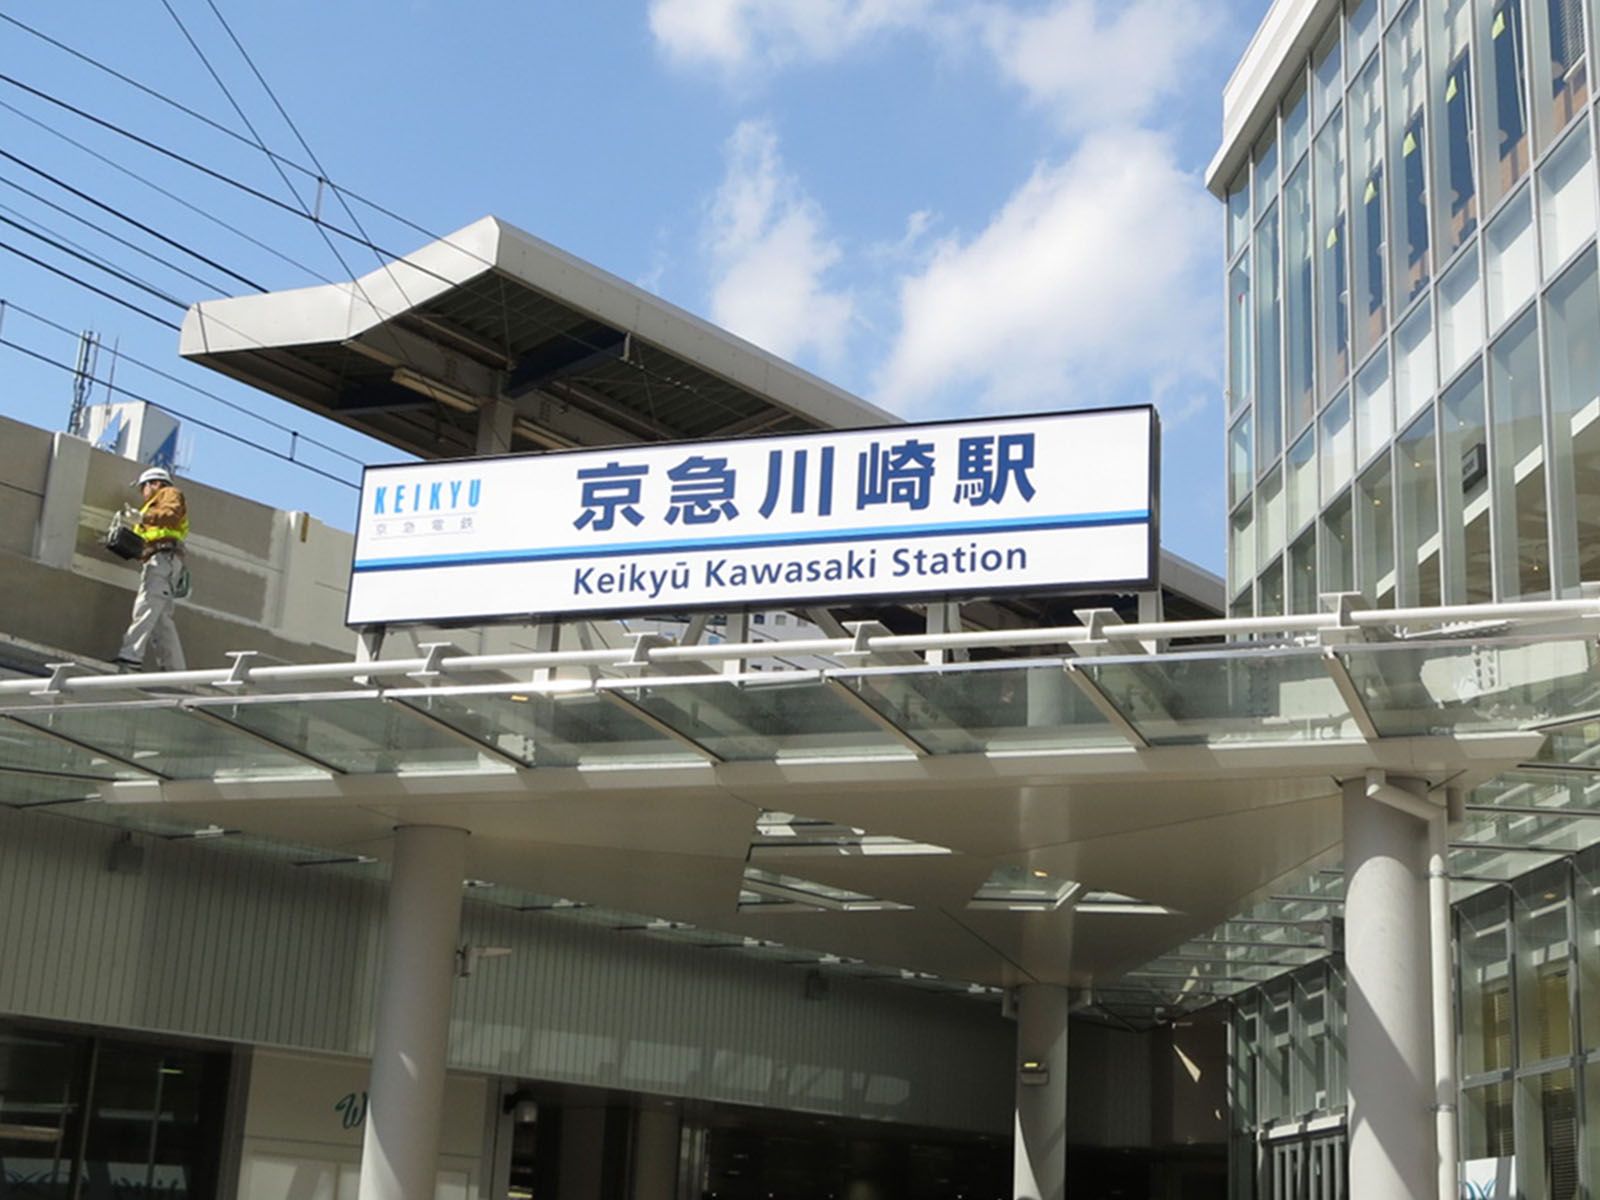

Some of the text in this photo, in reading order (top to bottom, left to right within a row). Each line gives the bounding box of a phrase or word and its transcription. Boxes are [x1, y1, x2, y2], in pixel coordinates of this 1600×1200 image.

[374, 479, 482, 515] KEIKYU
[573, 432, 1037, 532] 京急川崎駅
[573, 543, 1028, 598] Keikyū Kawasaki Station
